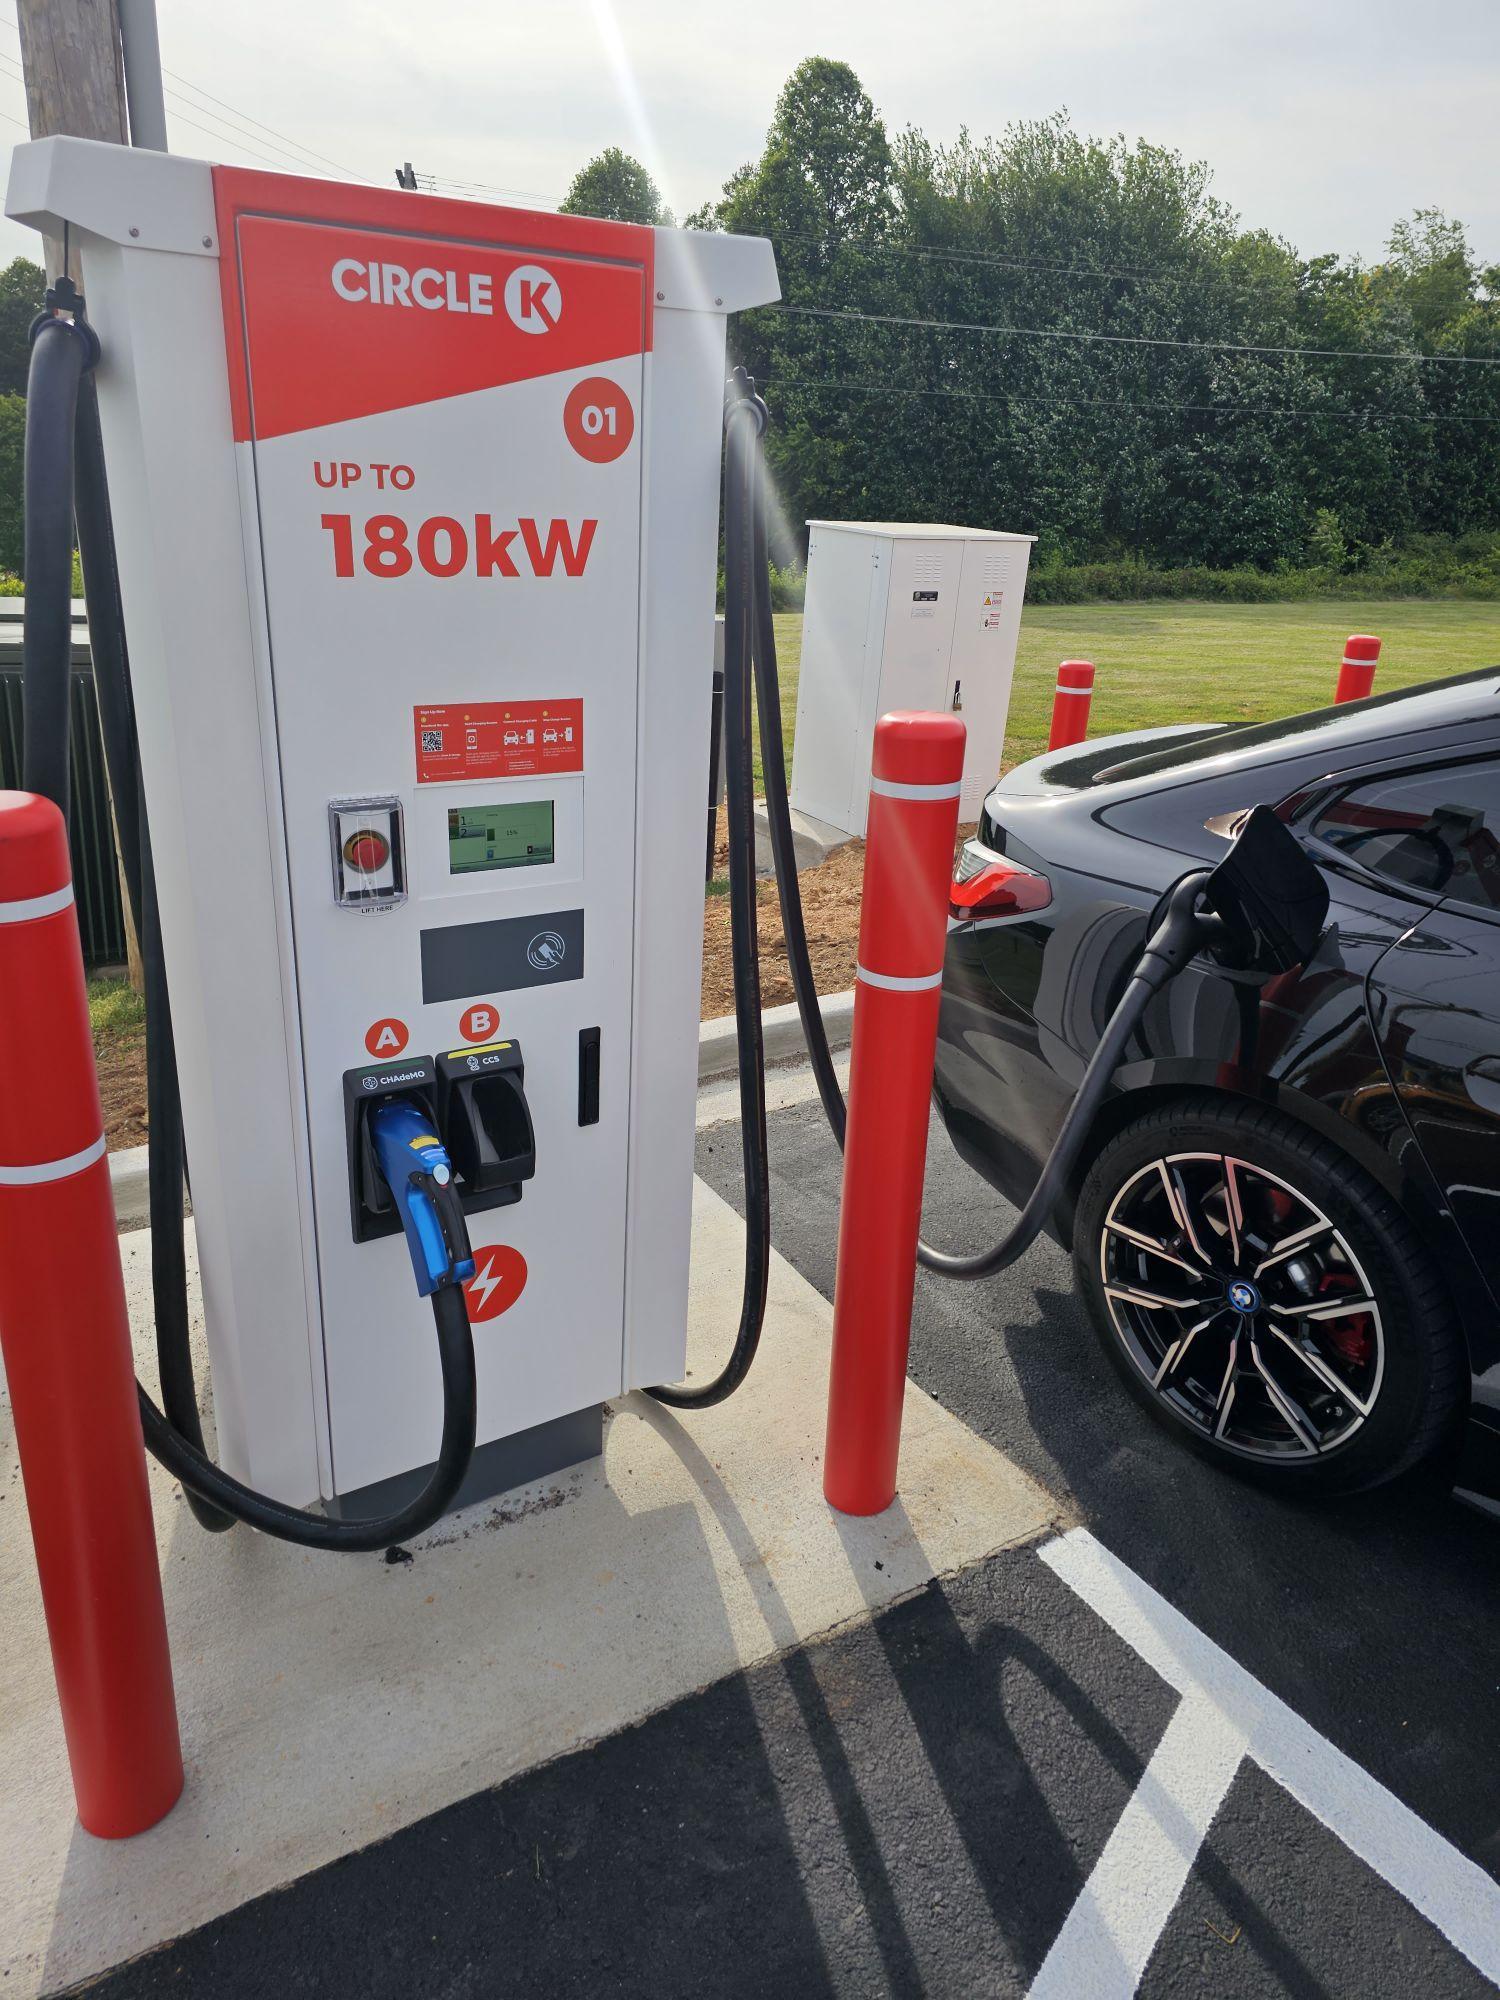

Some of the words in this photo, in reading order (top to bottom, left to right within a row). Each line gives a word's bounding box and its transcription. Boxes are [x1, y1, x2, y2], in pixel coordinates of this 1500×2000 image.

[331, 258, 493, 315] CIRCLE
[519, 279, 559, 331] K
[581, 405, 616, 436] 01
[314, 462, 361, 488] UP
[370, 464, 415, 491] TO
[321, 514, 598, 578] 180kW
[460, 816, 467, 826] 1
[460, 828, 467, 838] 2
[376, 904, 393, 913] HERE
[471, 1011, 491, 1033] B
[376, 1026, 400, 1050] A
[482, 1055, 500, 1065] CCS
[380, 1070, 425, 1085] CHAdeMO
